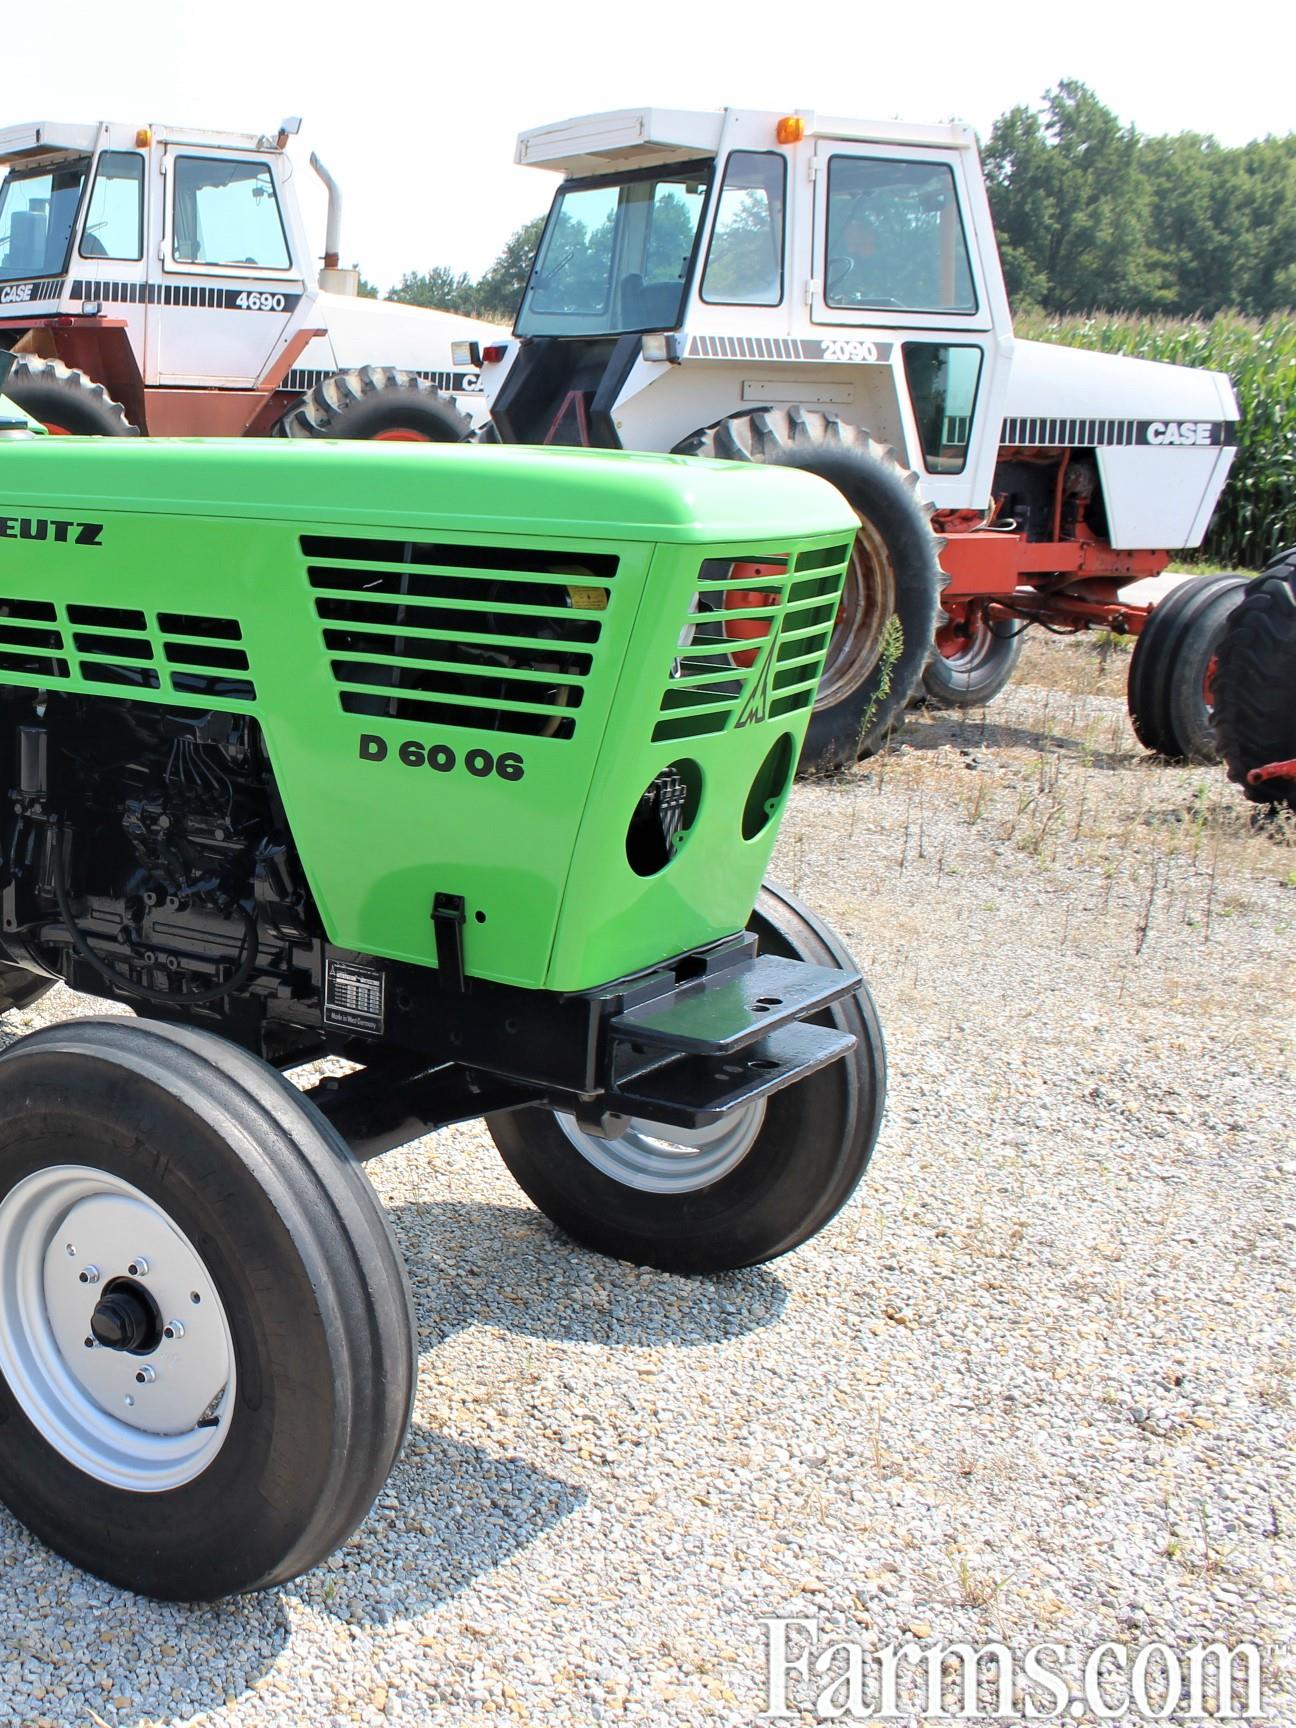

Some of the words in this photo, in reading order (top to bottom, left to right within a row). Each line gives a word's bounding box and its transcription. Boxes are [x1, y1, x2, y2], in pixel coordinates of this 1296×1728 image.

[0, 284, 34, 303] CASE
[235, 291, 285, 311] 4690
[820, 340, 878, 361] 2090
[1146, 422, 1213, 445] CASE
[359, 733, 388, 762] D
